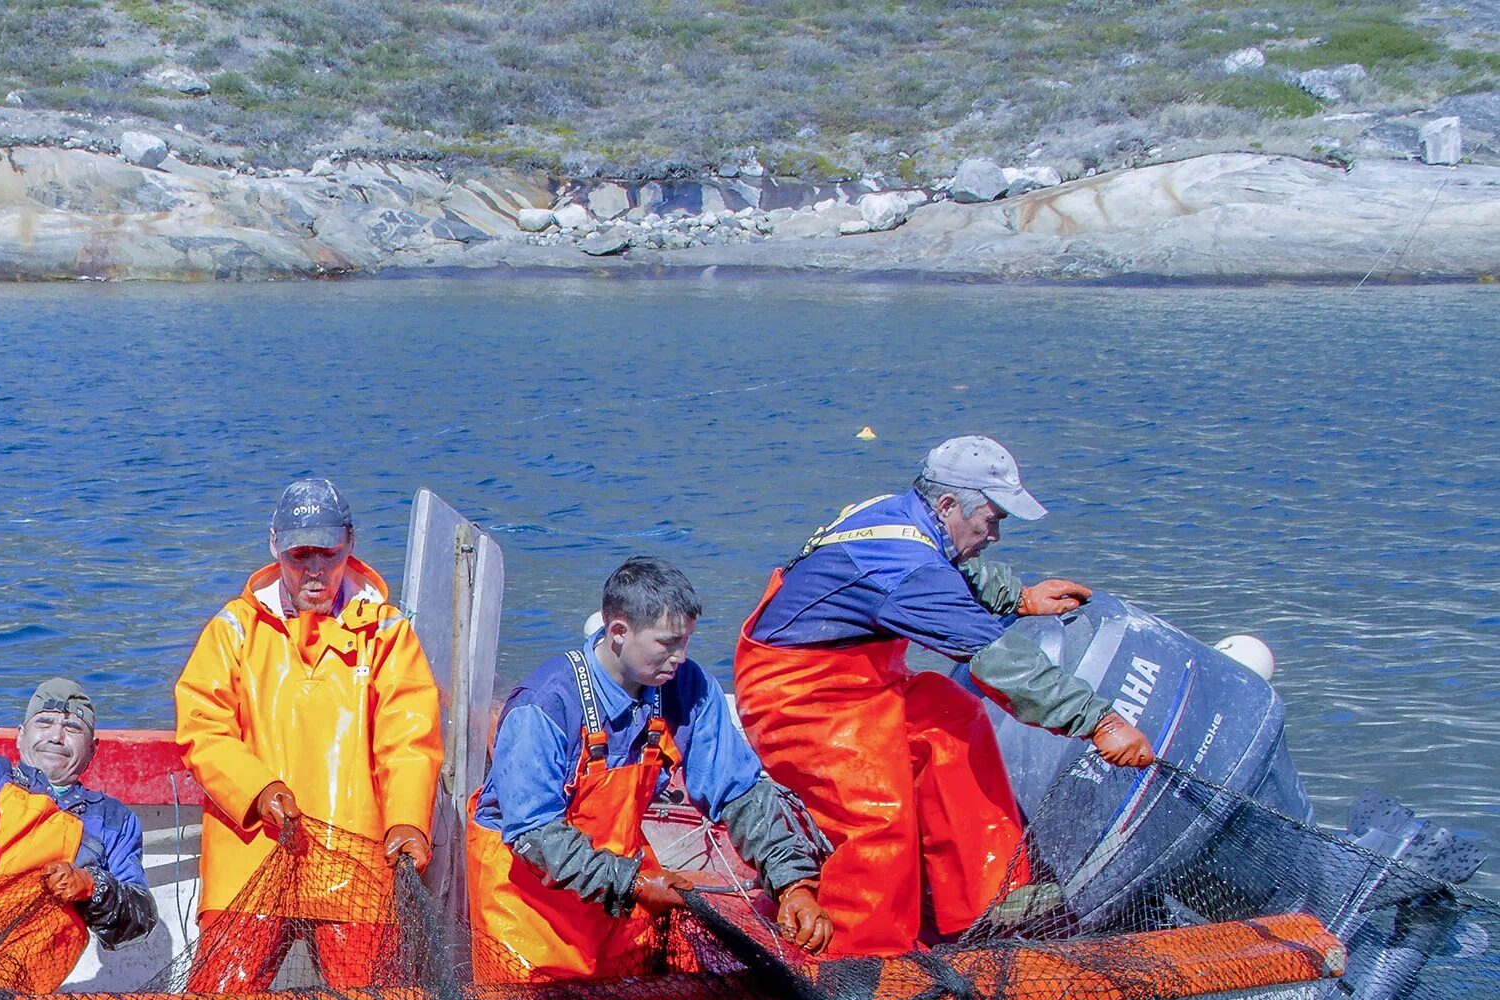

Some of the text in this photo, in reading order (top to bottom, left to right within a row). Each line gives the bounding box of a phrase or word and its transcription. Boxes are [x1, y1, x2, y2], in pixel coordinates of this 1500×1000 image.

[293, 505, 321, 516] ODIM
[577, 666, 592, 700] OCEAN
[587, 706, 598, 734] CEAN
[1070, 656, 1162, 785] YAHA
[1193, 712, 1224, 764] stroke
